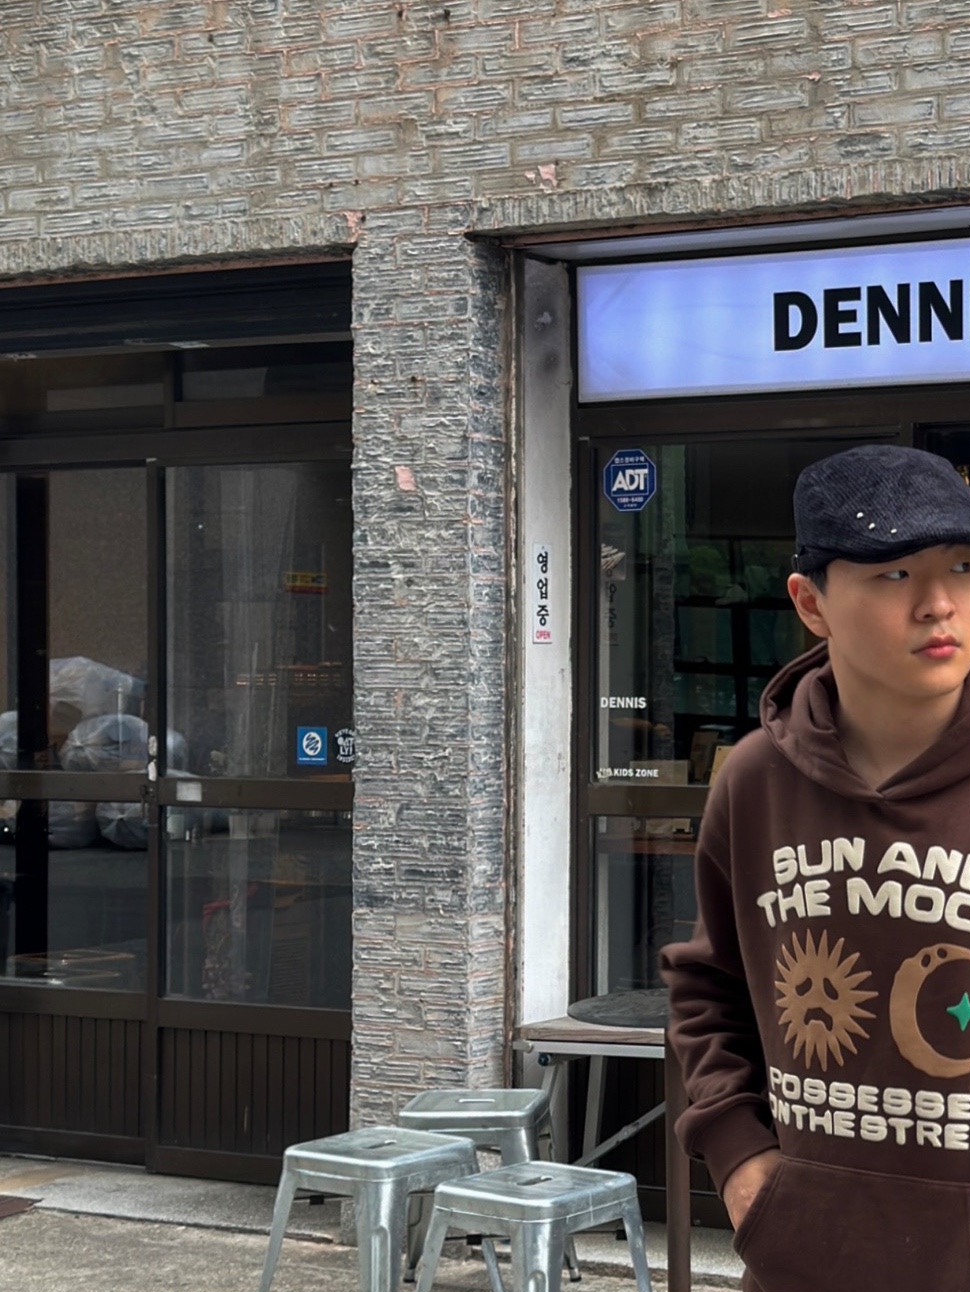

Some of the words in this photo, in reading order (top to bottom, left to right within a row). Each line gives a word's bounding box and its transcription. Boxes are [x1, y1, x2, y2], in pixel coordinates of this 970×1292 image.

[612, 468, 648, 491] ADT
[536, 551, 549, 626] 영업중
[536, 630, 551, 640] OPEN
[600, 696, 647, 709] DENNIS
[613, 768, 634, 777] KIDS
[635, 768, 659, 777] ZONE
[773, 837, 865, 885] SUN
[757, 879, 831, 928] THE
